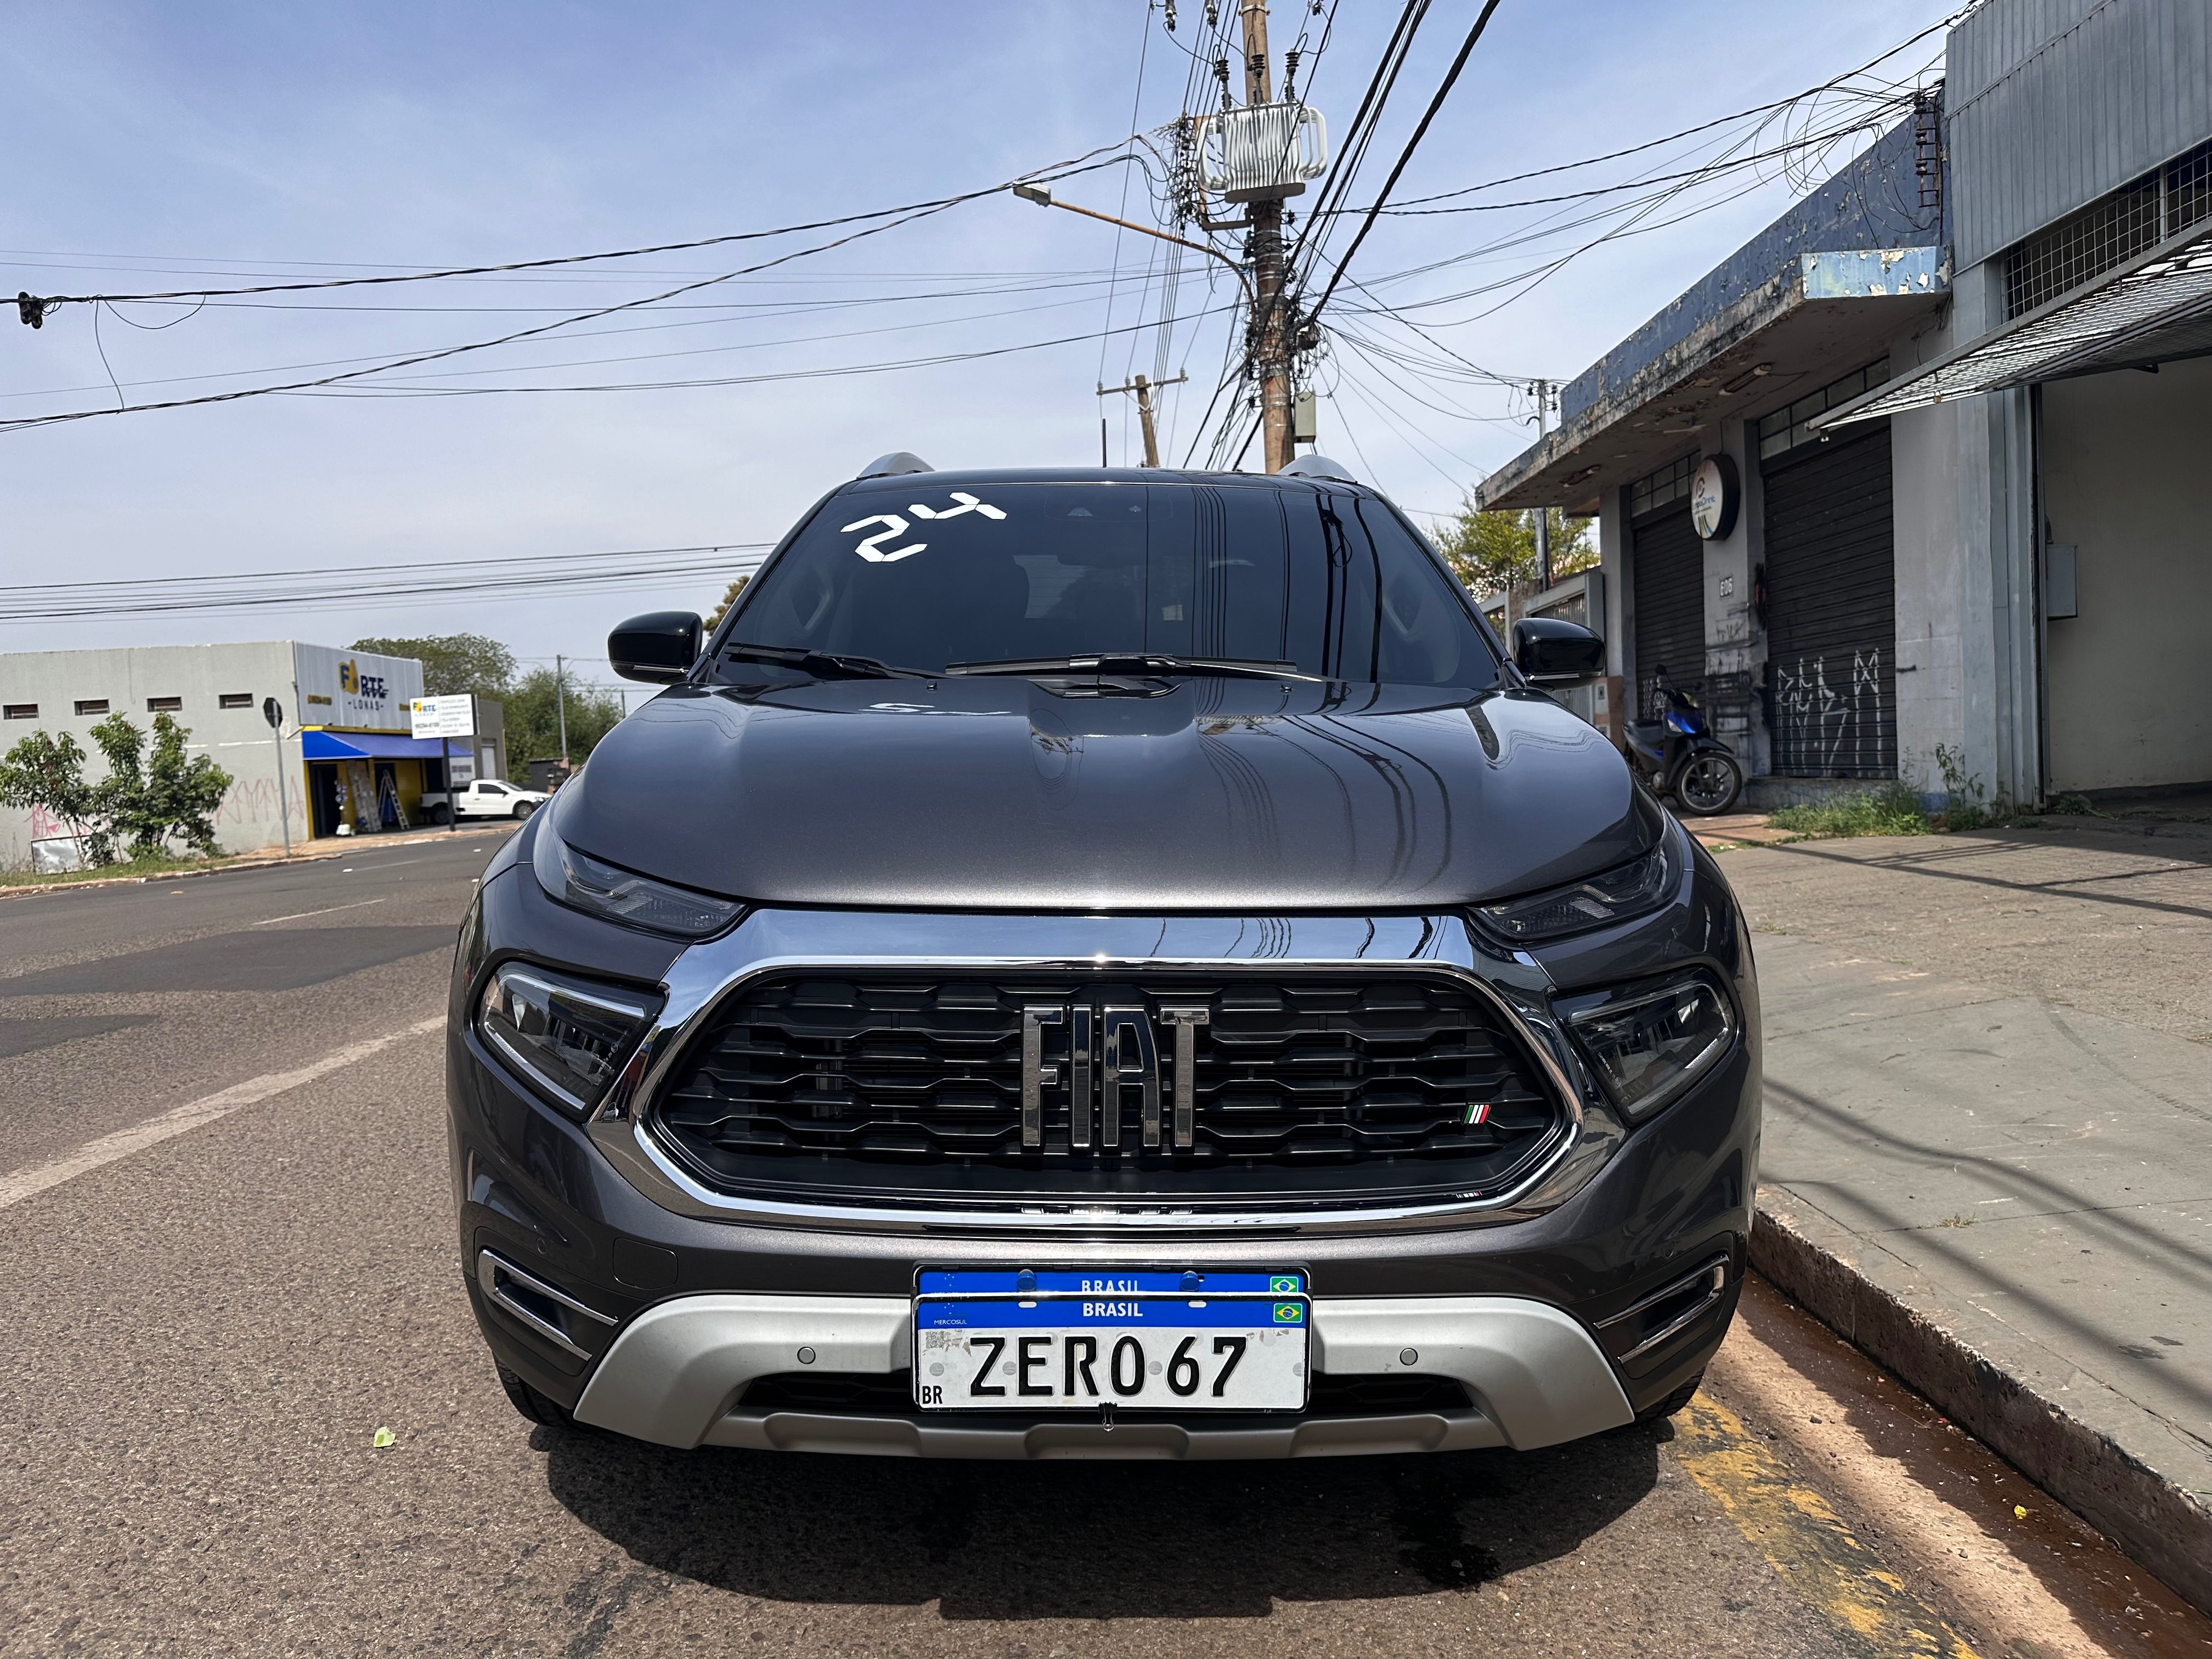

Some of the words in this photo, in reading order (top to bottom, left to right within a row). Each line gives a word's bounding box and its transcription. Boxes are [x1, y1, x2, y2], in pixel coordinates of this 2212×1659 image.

[840, 492, 1007, 563] 24
[1022, 1005, 1211, 1147] FIAT
[1083, 1302, 1143, 1317] BRASIL
[922, 1385, 943, 1404] BR
